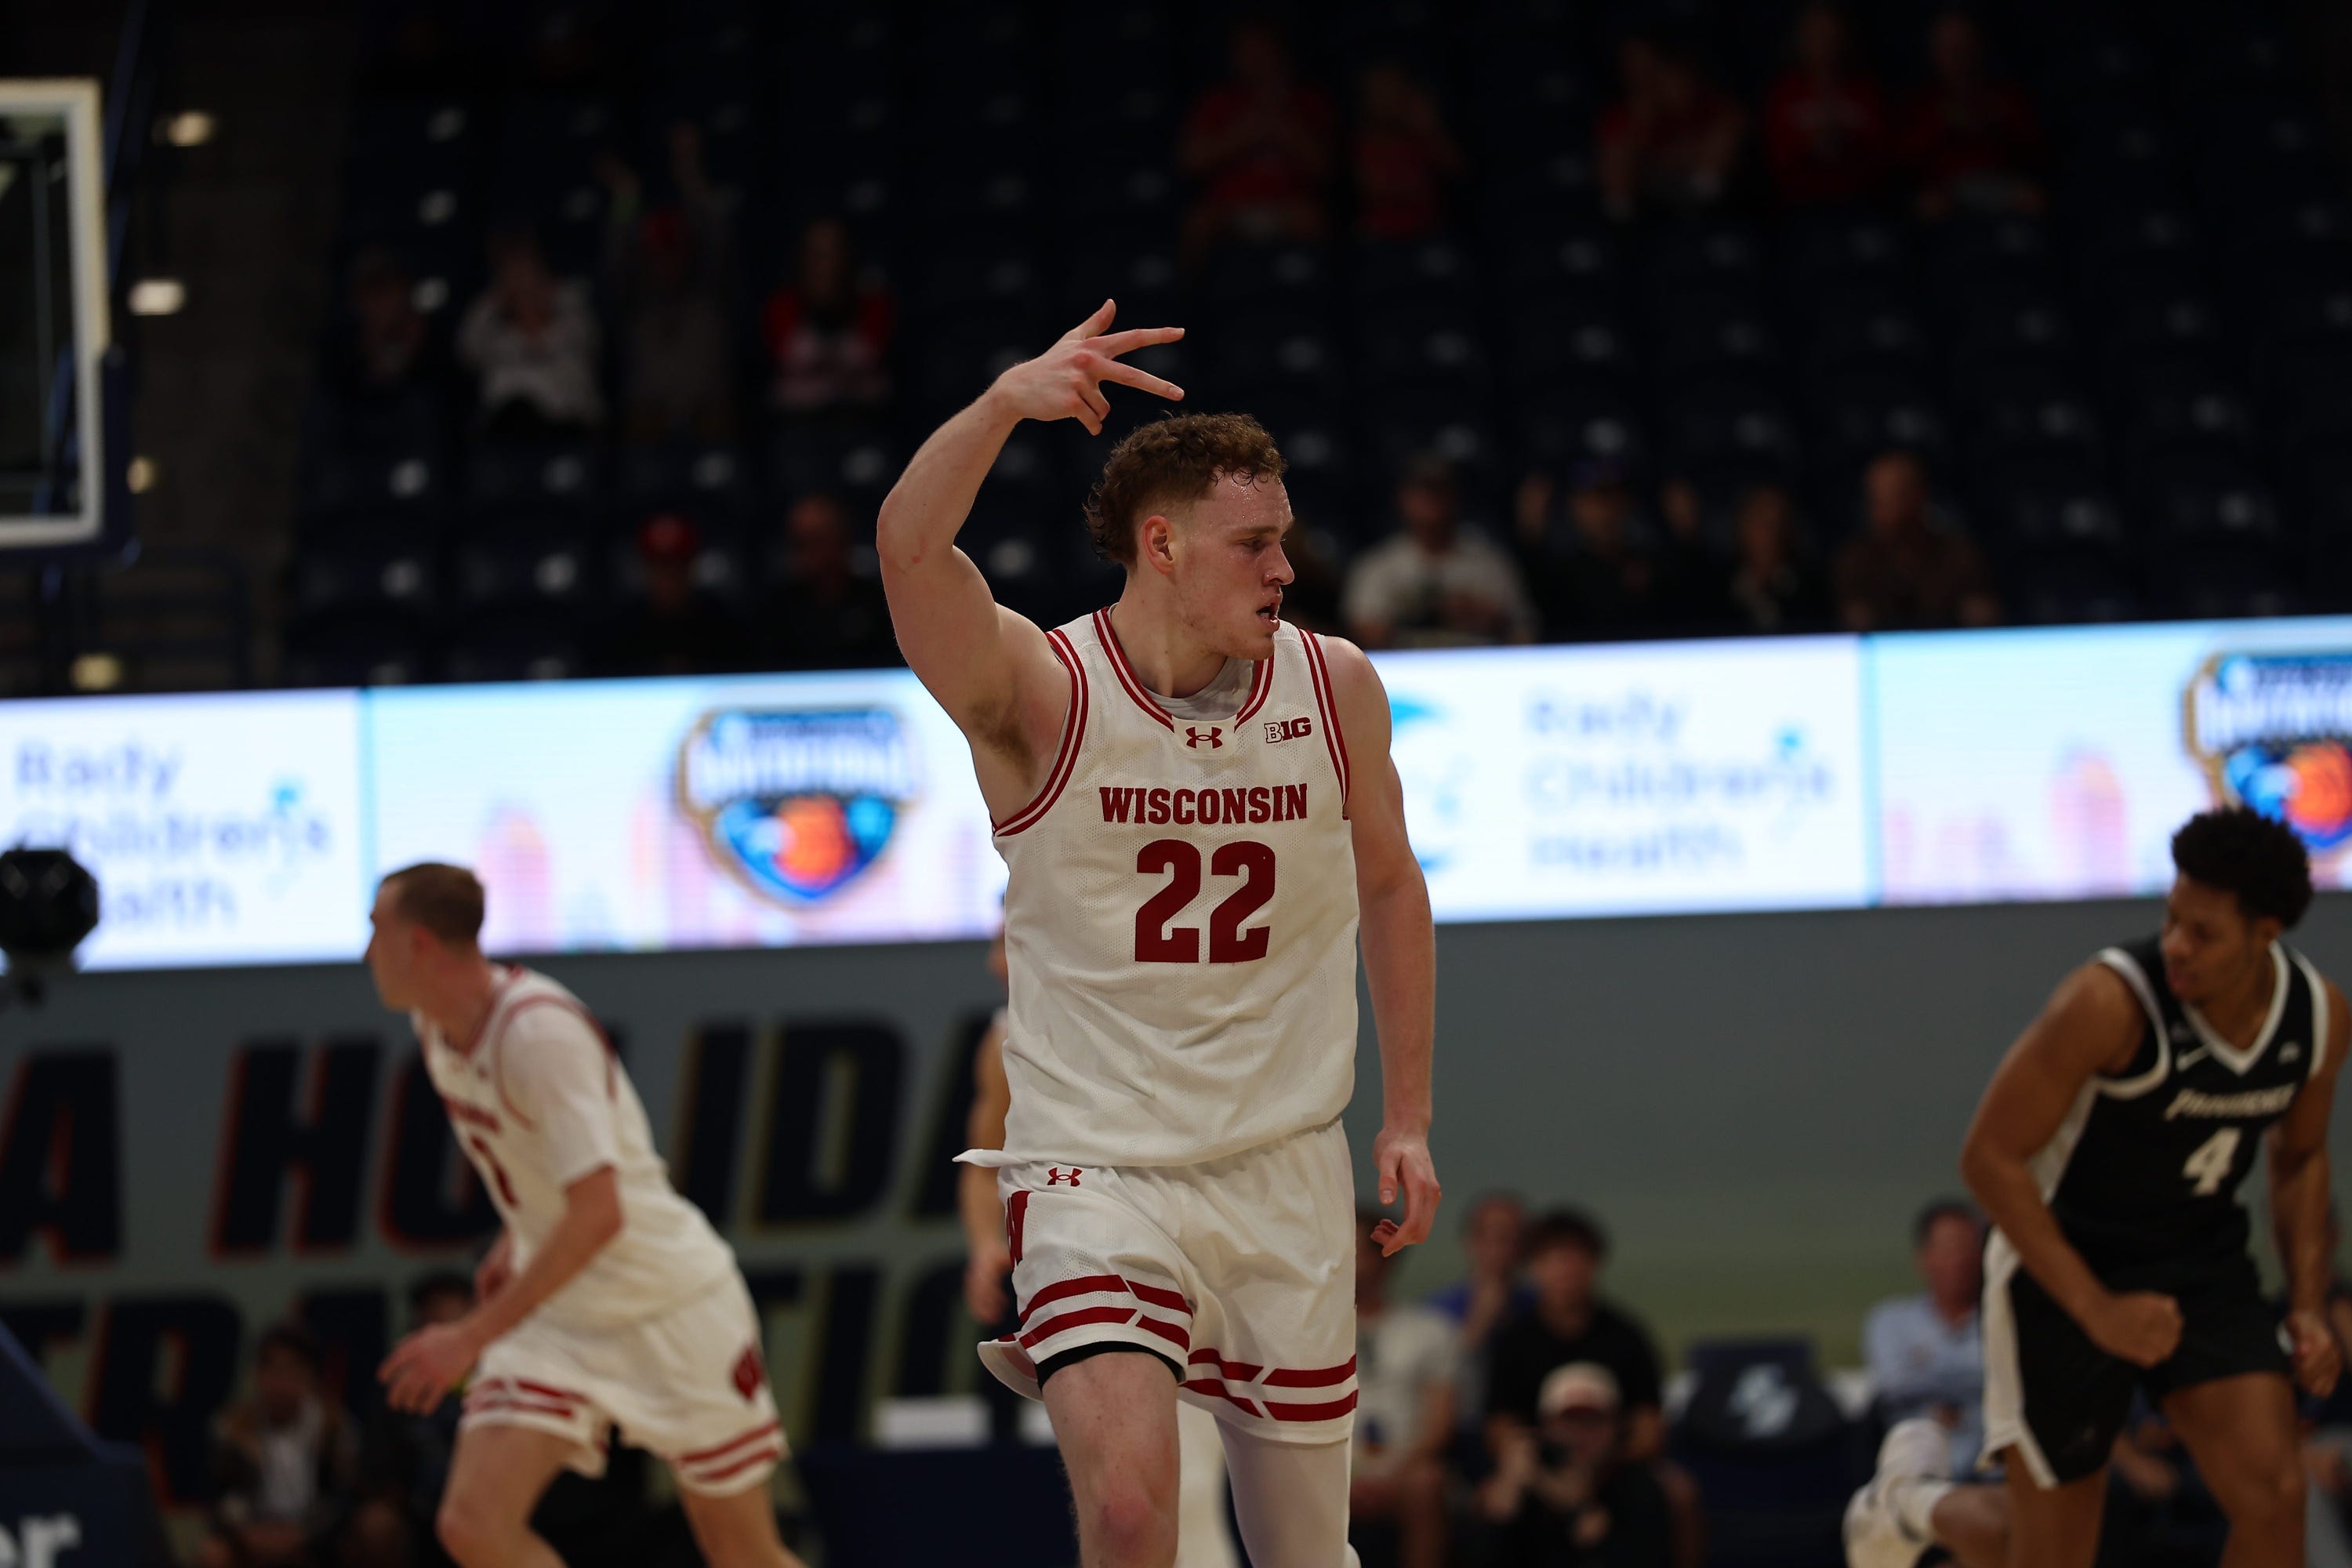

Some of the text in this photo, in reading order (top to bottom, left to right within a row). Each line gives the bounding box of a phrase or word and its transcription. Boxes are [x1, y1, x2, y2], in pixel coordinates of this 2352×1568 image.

[1098, 783, 1308, 825] WISCONSIN
[102, 873, 240, 931] alth
[1134, 839, 1276, 964] 22
[2182, 1127, 2242, 1197] 4
